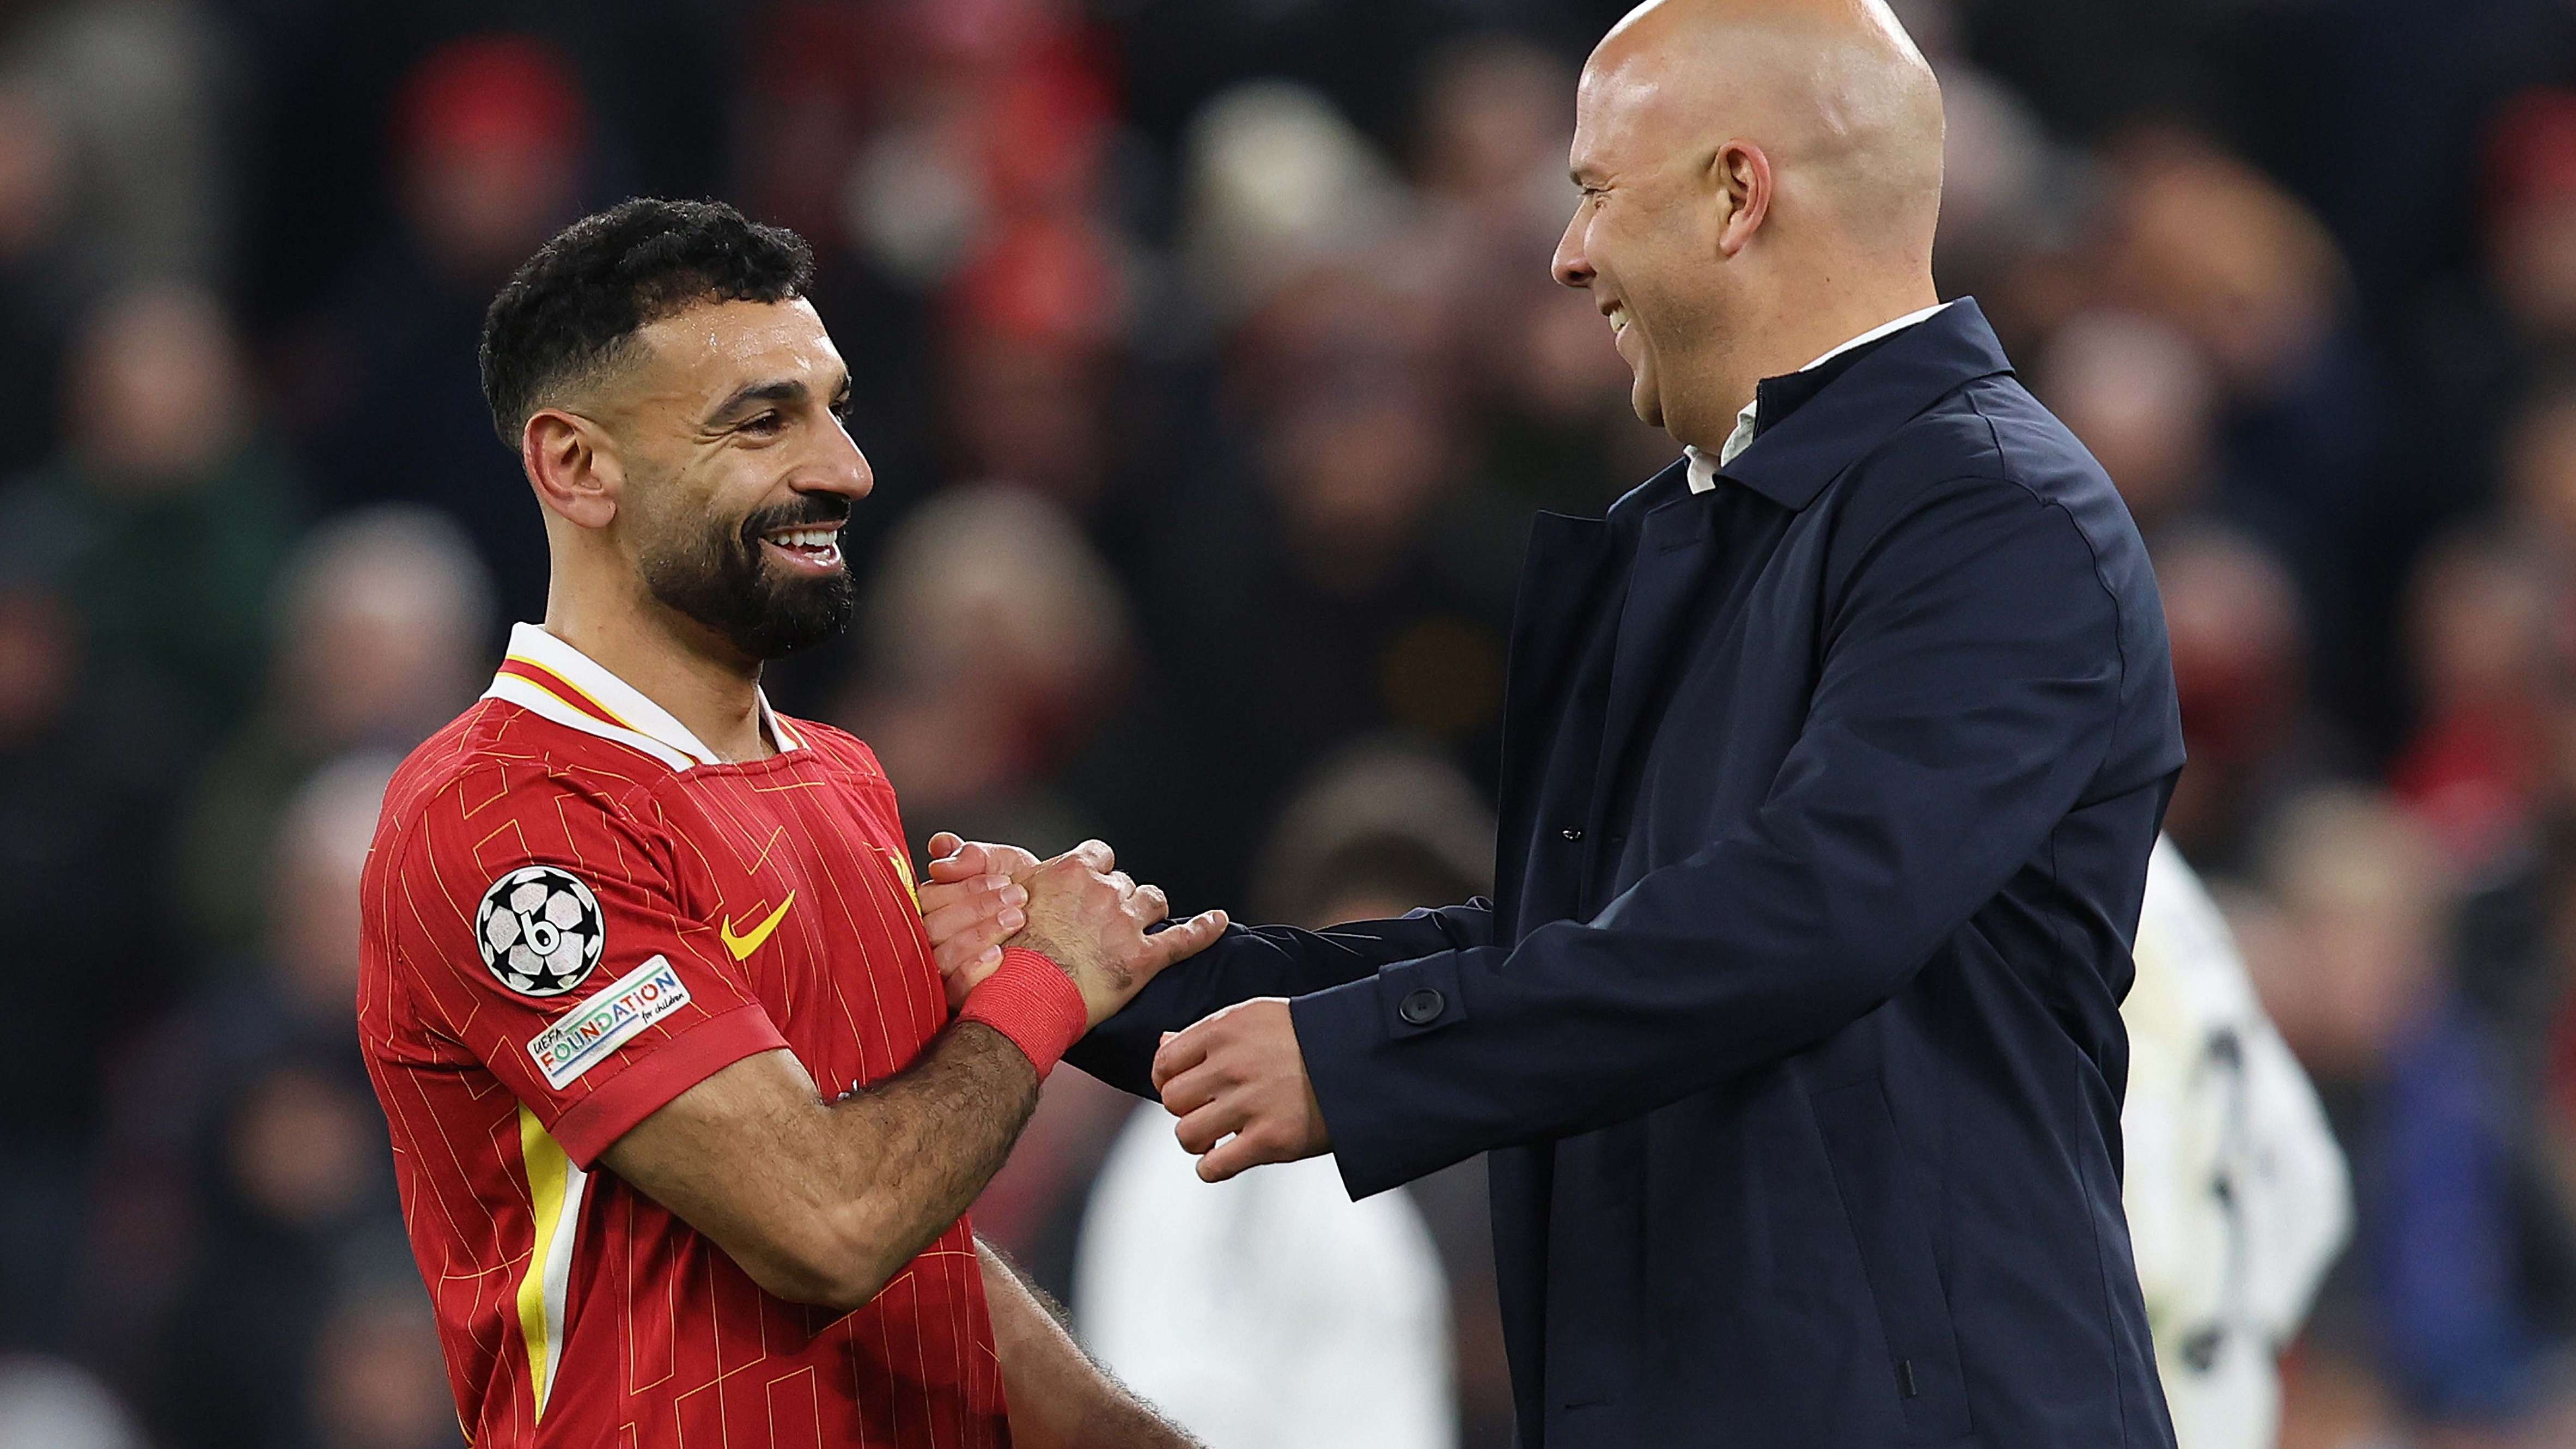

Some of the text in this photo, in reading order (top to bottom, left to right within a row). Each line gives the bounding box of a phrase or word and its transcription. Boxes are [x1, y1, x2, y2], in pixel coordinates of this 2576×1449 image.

[521, 910, 559, 955] 6
[642, 993, 684, 1024] for children
[533, 1028, 564, 1054] UEFA
